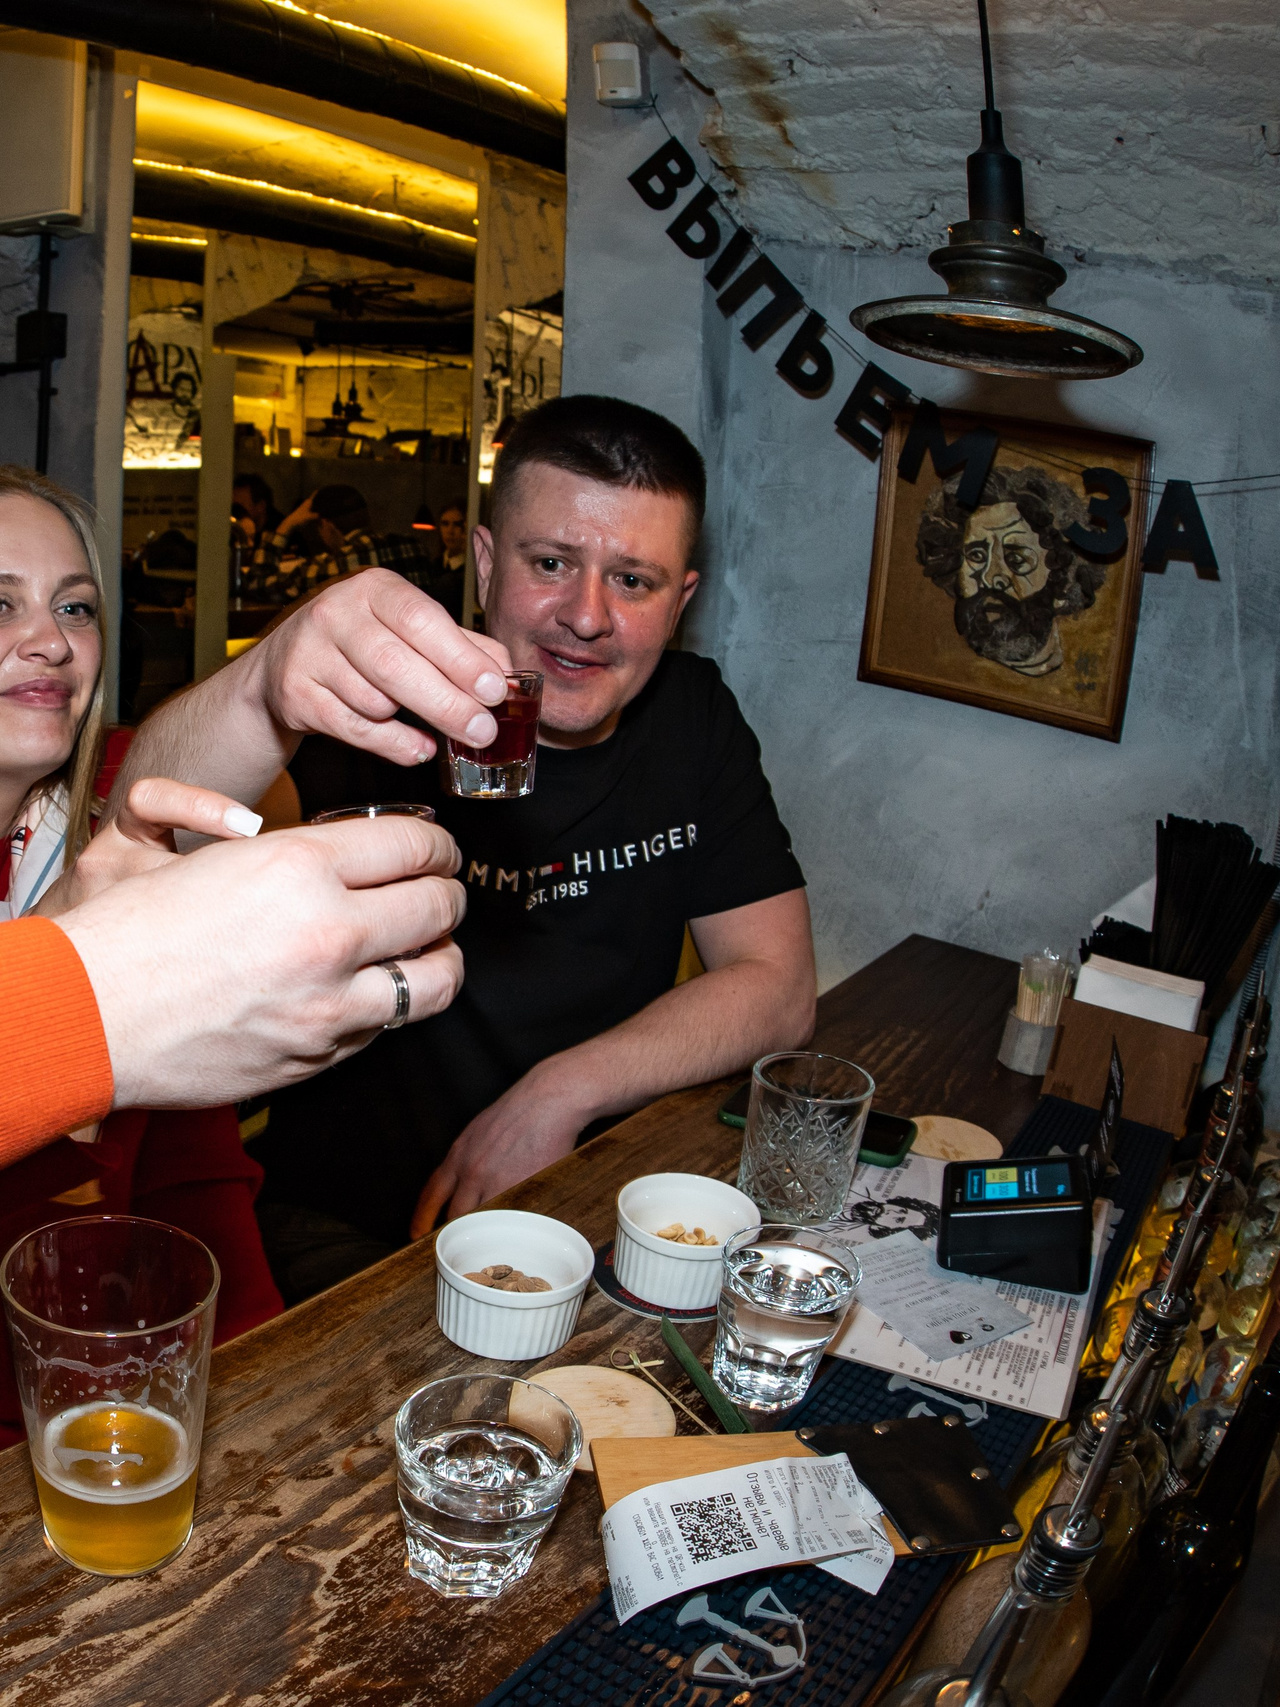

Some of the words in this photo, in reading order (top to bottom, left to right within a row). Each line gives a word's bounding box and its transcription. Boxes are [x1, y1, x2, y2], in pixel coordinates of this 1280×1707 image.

[627, 136, 1001, 508] ВЫПЬЕМ
[1064, 466, 1219, 573] ЗА
[467, 859, 537, 893] MMY
[572, 822, 698, 875] HILFIGER
[525, 888, 548, 911] EST.
[552, 880, 589, 900] 1985
[631, 1513, 647, 1537] СПАСИБО!
[646, 1507, 659, 1528] введите
[662, 1548, 670, 1556] на
[653, 1501, 668, 1525] Наведите
[662, 1526, 675, 1545] камеру
[670, 1545, 678, 1553] на
[741, 1496, 770, 1539] нетмонет
[745, 1471, 767, 1506] Отзывы
[767, 1518, 790, 1551] чаевые
[646, 1551, 656, 1562] ВАС
[650, 1562, 664, 1581] СНОВА!
